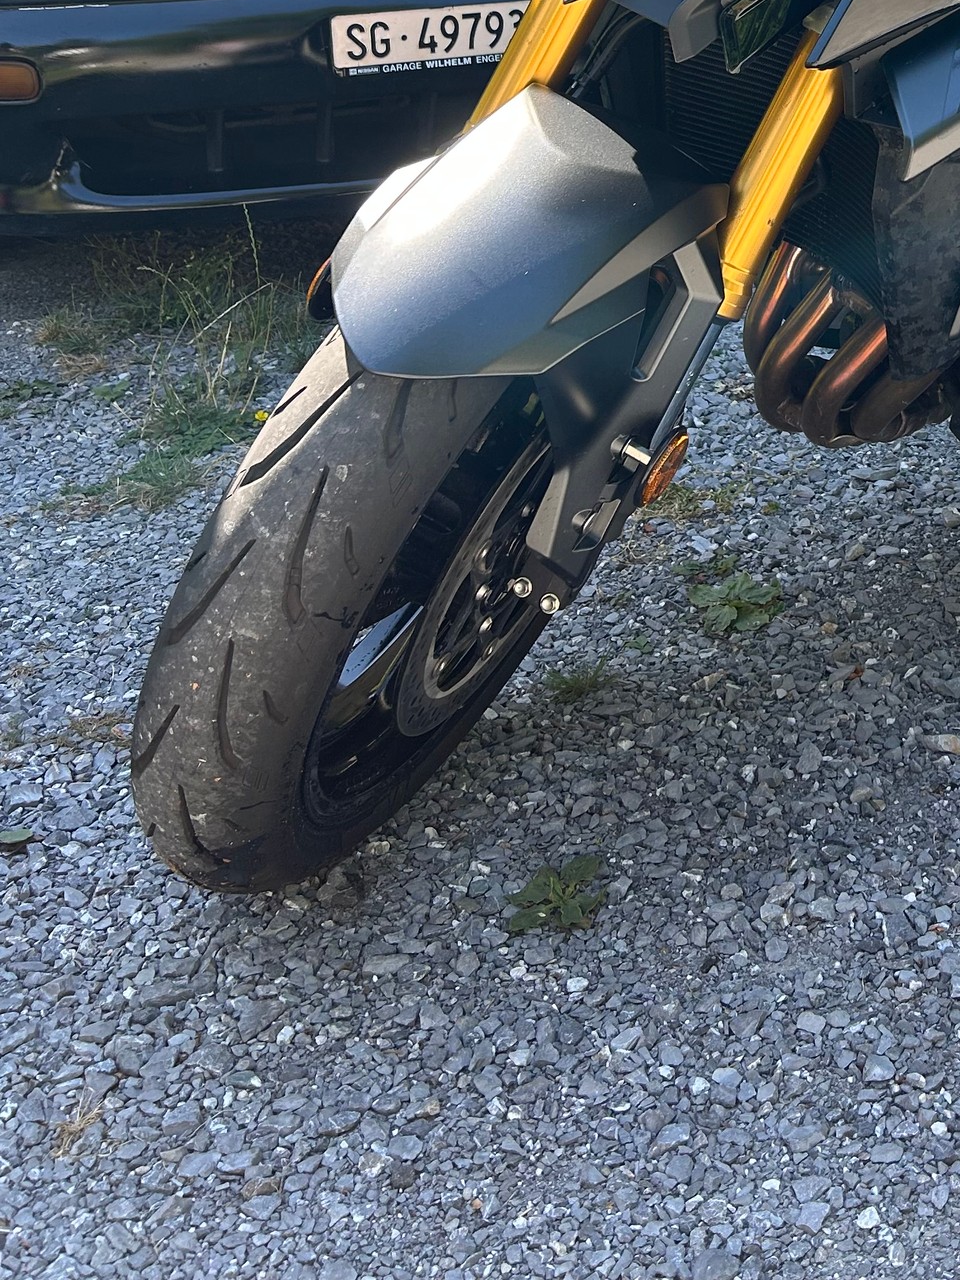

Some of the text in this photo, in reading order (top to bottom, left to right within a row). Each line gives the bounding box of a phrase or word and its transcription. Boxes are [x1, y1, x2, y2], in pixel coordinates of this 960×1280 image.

[346, 21, 391, 61] SG
[382, 53, 503, 73] GARAGE WILHELM ENGE
